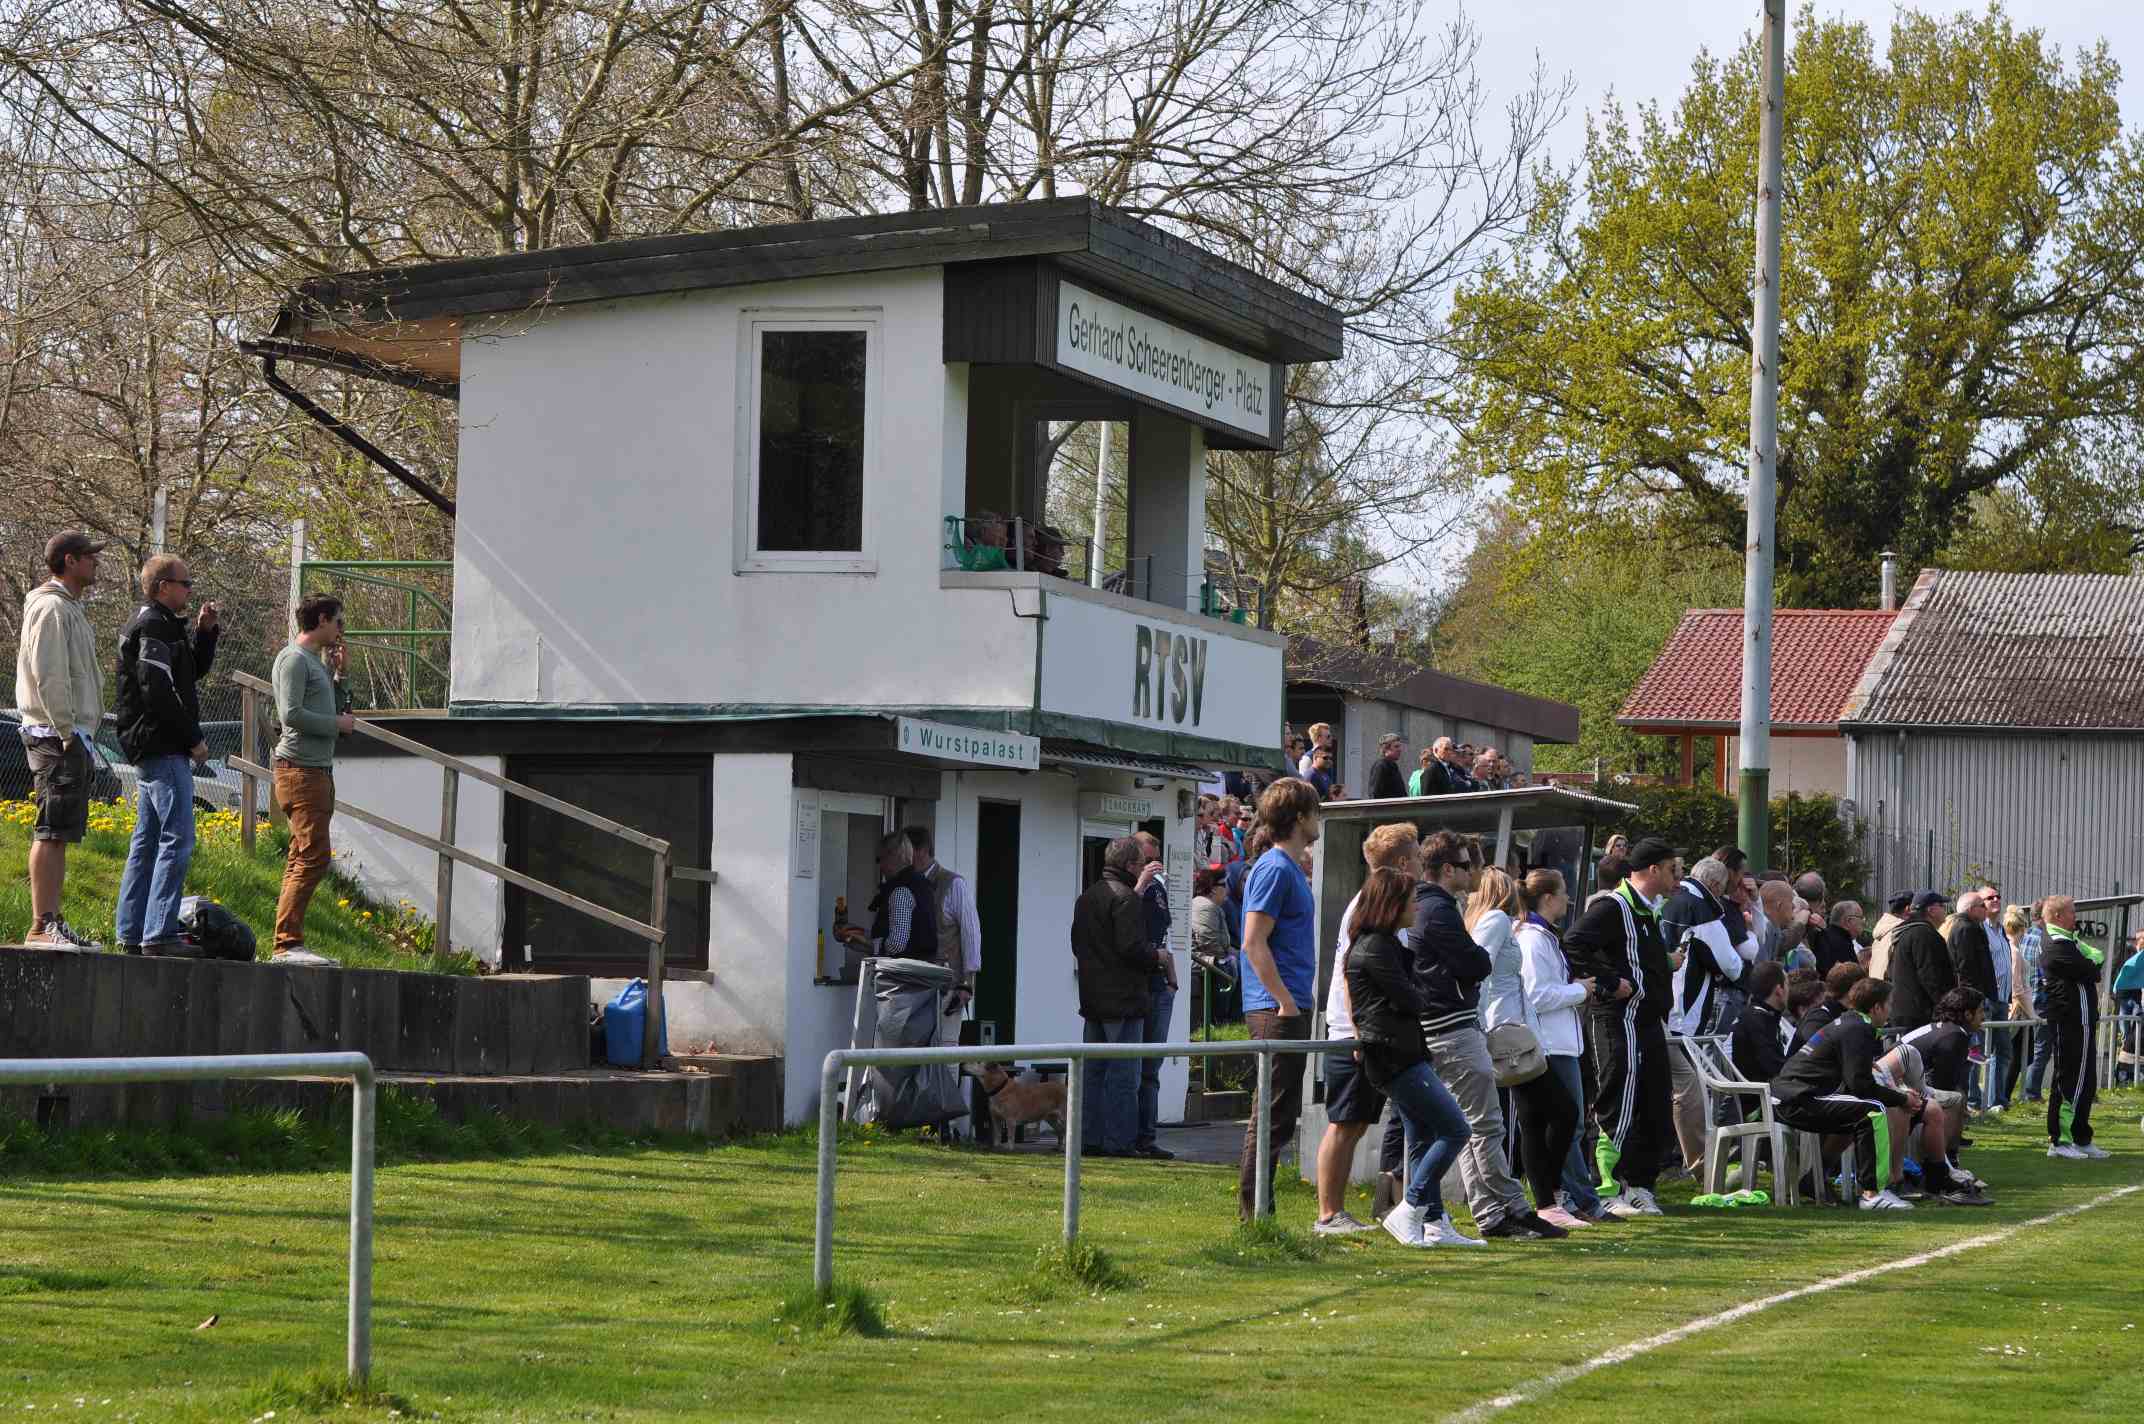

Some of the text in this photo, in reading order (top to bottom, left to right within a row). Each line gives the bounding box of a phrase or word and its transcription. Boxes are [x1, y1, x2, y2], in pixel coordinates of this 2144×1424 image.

[1069, 302, 1124, 366] Gerhard
[1127, 326, 1226, 409] Scheerenberger
[1236, 368, 1262, 416] Platz
[1133, 624, 1207, 726] RTSV
[920, 727, 1023, 760] Wurstpalast
